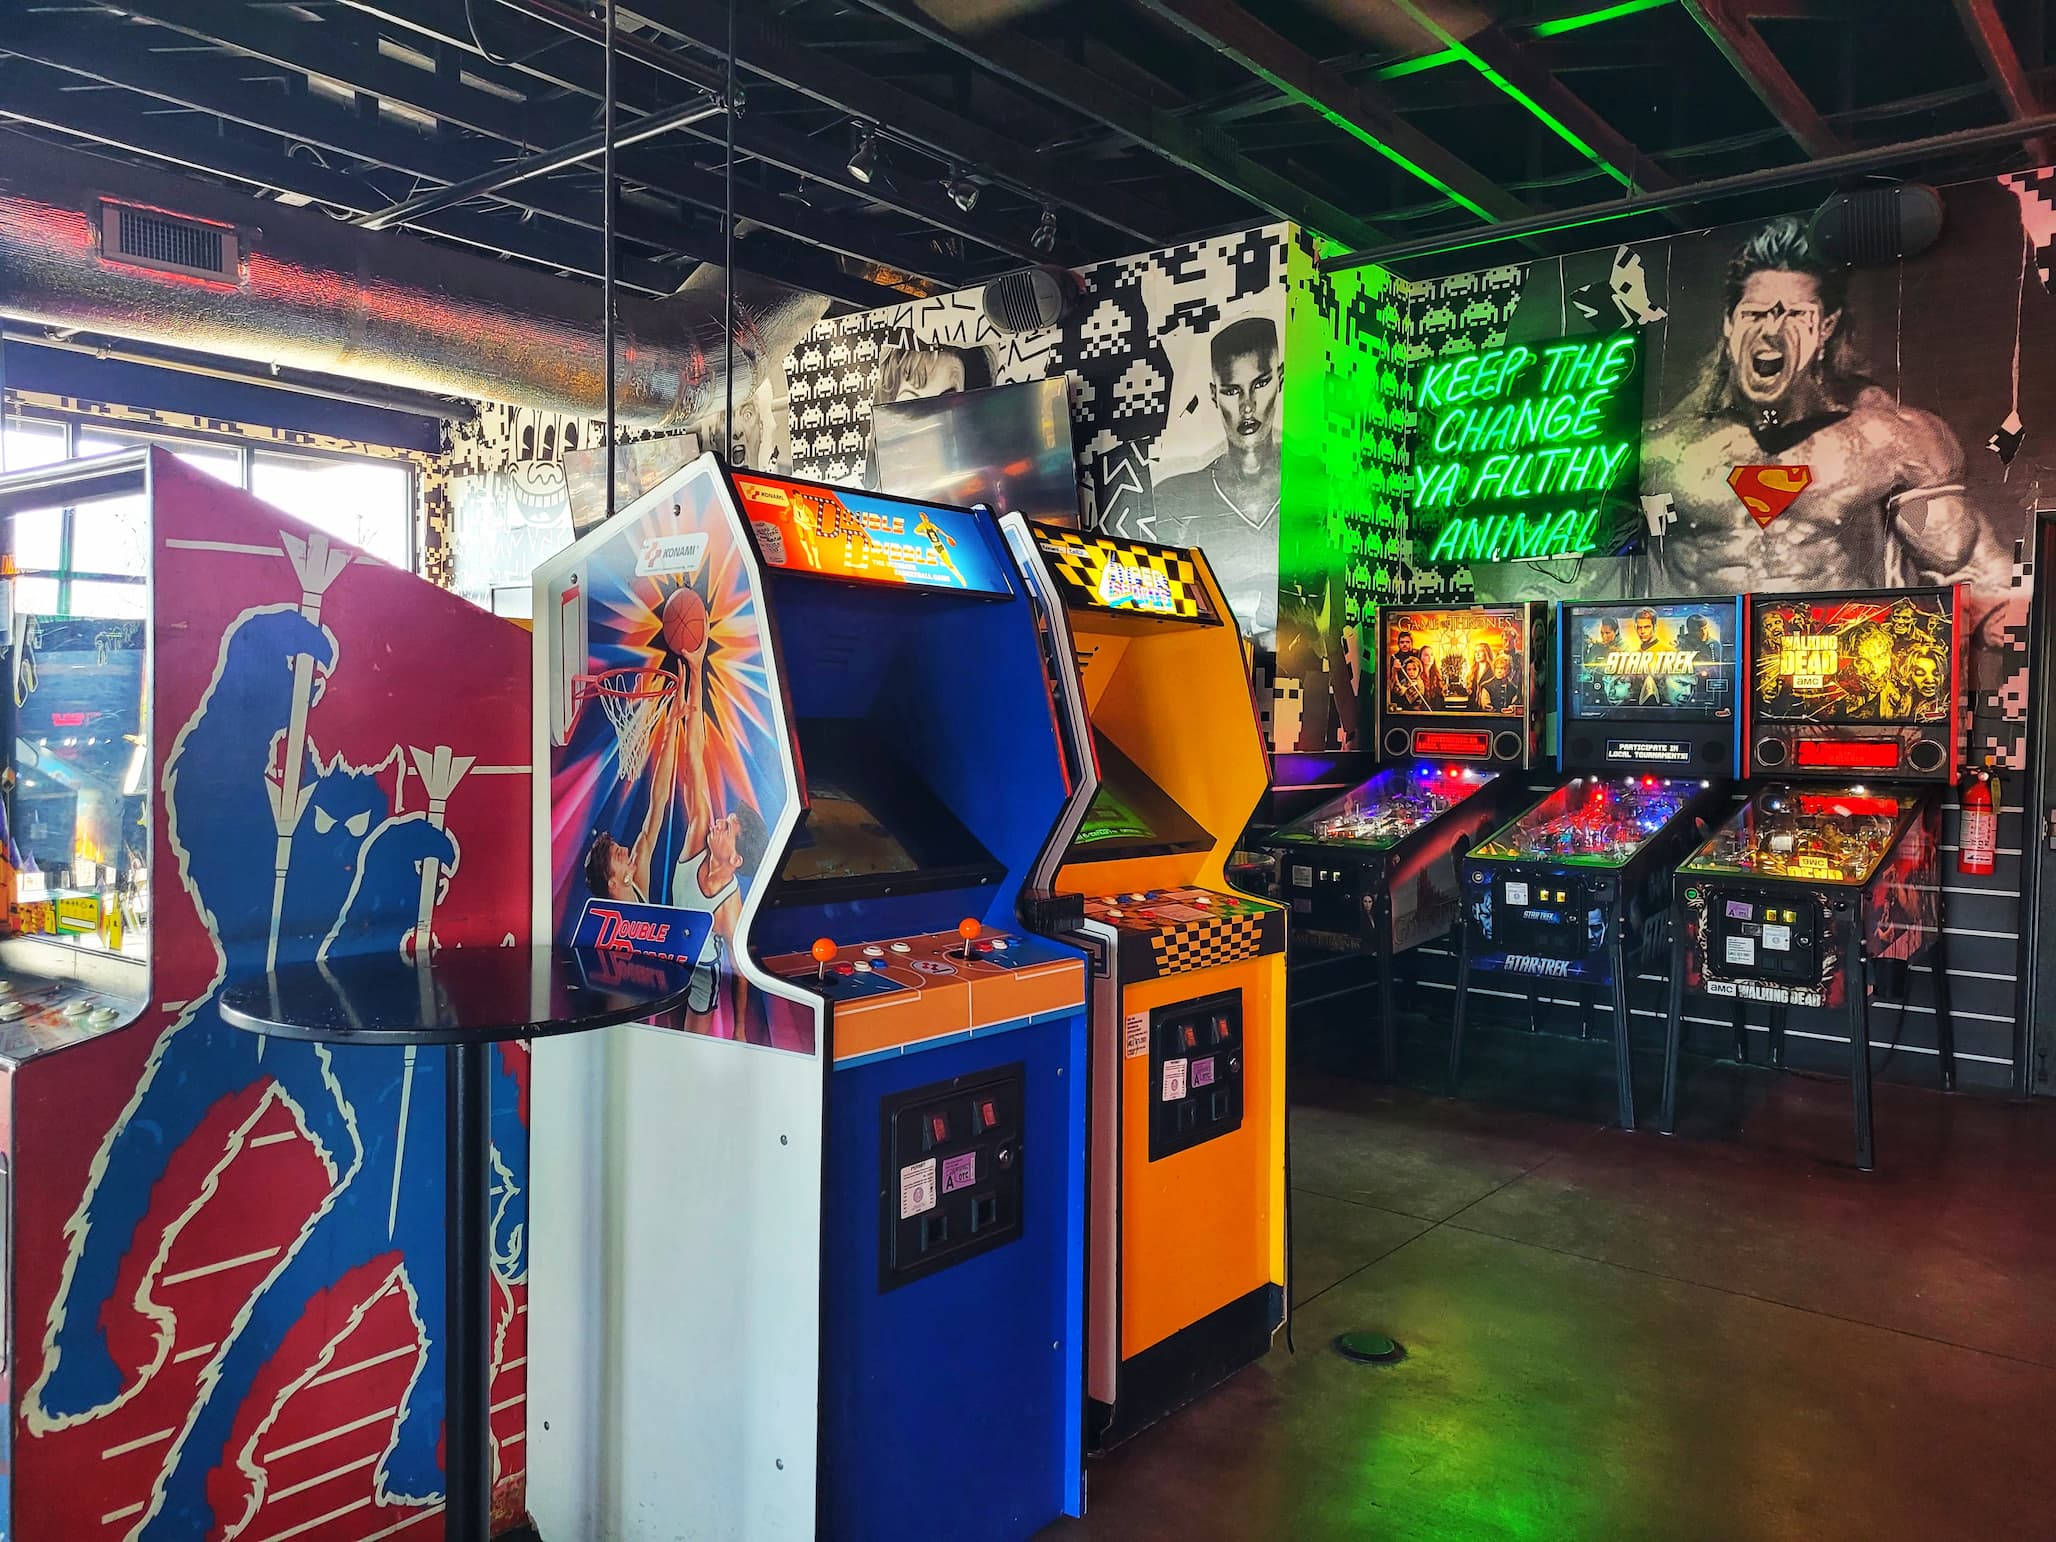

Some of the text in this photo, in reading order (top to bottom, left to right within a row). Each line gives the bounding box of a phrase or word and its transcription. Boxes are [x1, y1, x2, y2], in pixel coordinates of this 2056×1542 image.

[1418, 337, 1635, 408] KEEP THE
[1434, 388, 1609, 453] CHANGE
[1414, 442, 1629, 508] YA FILTHY
[802, 493, 905, 538] DOUBLE
[1429, 508, 1600, 561] ANIMAL
[662, 545, 697, 559] KONAMI
[840, 527, 939, 569] DRIBBLE
[1398, 616, 1439, 632] GAME
[1447, 615, 1514, 632] THRONES
[1780, 635, 1838, 651] WALKING
[1604, 651, 1700, 675] STAR TREK
[1780, 650, 1838, 676] DEAD
[1619, 743, 1679, 752] PARTICIPATE IN
[1540, 912, 1554, 921] TREK
[589, 908, 670, 950] DOUBLE
[1504, 954, 1570, 978] STAR TREK
[1738, 984, 1821, 1007] WALKING DEAD
[945, 1175, 954, 1190] A
